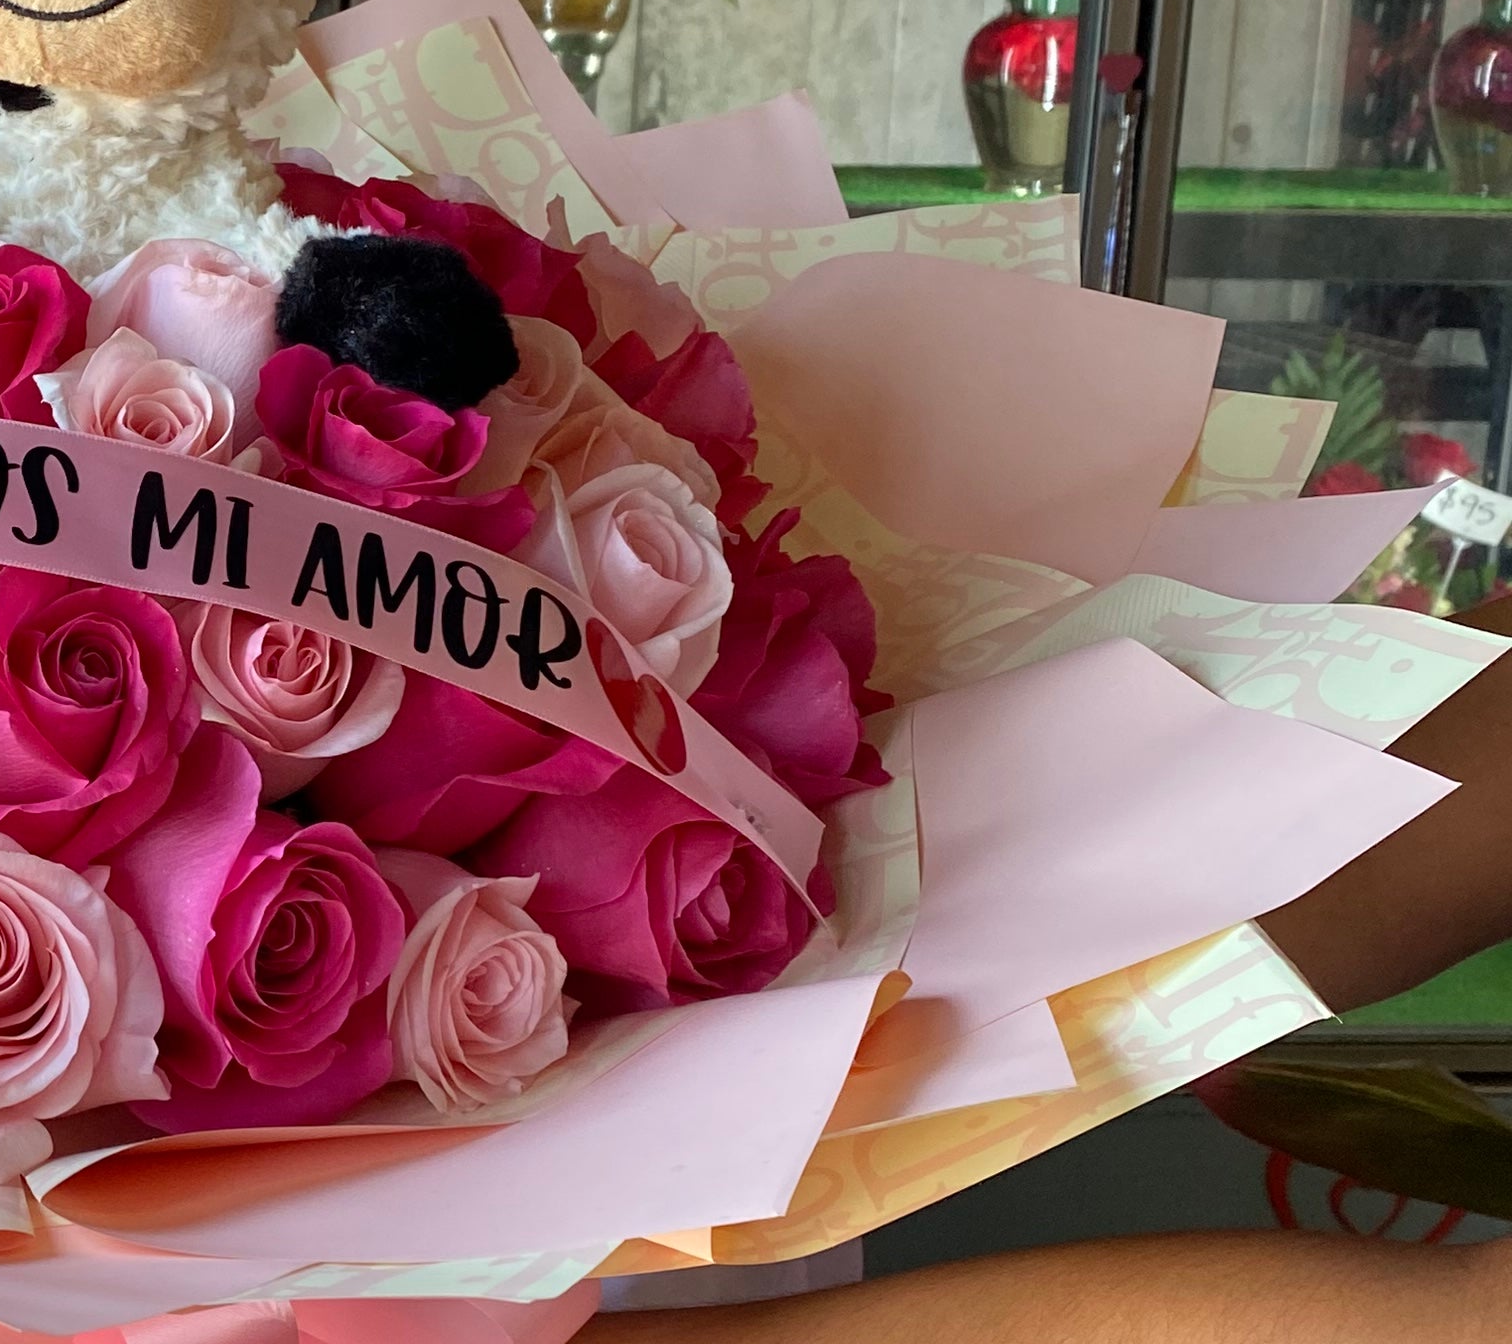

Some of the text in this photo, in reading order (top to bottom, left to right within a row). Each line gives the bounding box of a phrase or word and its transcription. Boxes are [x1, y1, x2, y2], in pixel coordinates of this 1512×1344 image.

[1437, 485, 1497, 528] $95
[130, 470, 255, 590] MI
[291, 522, 582, 691] AMOR
